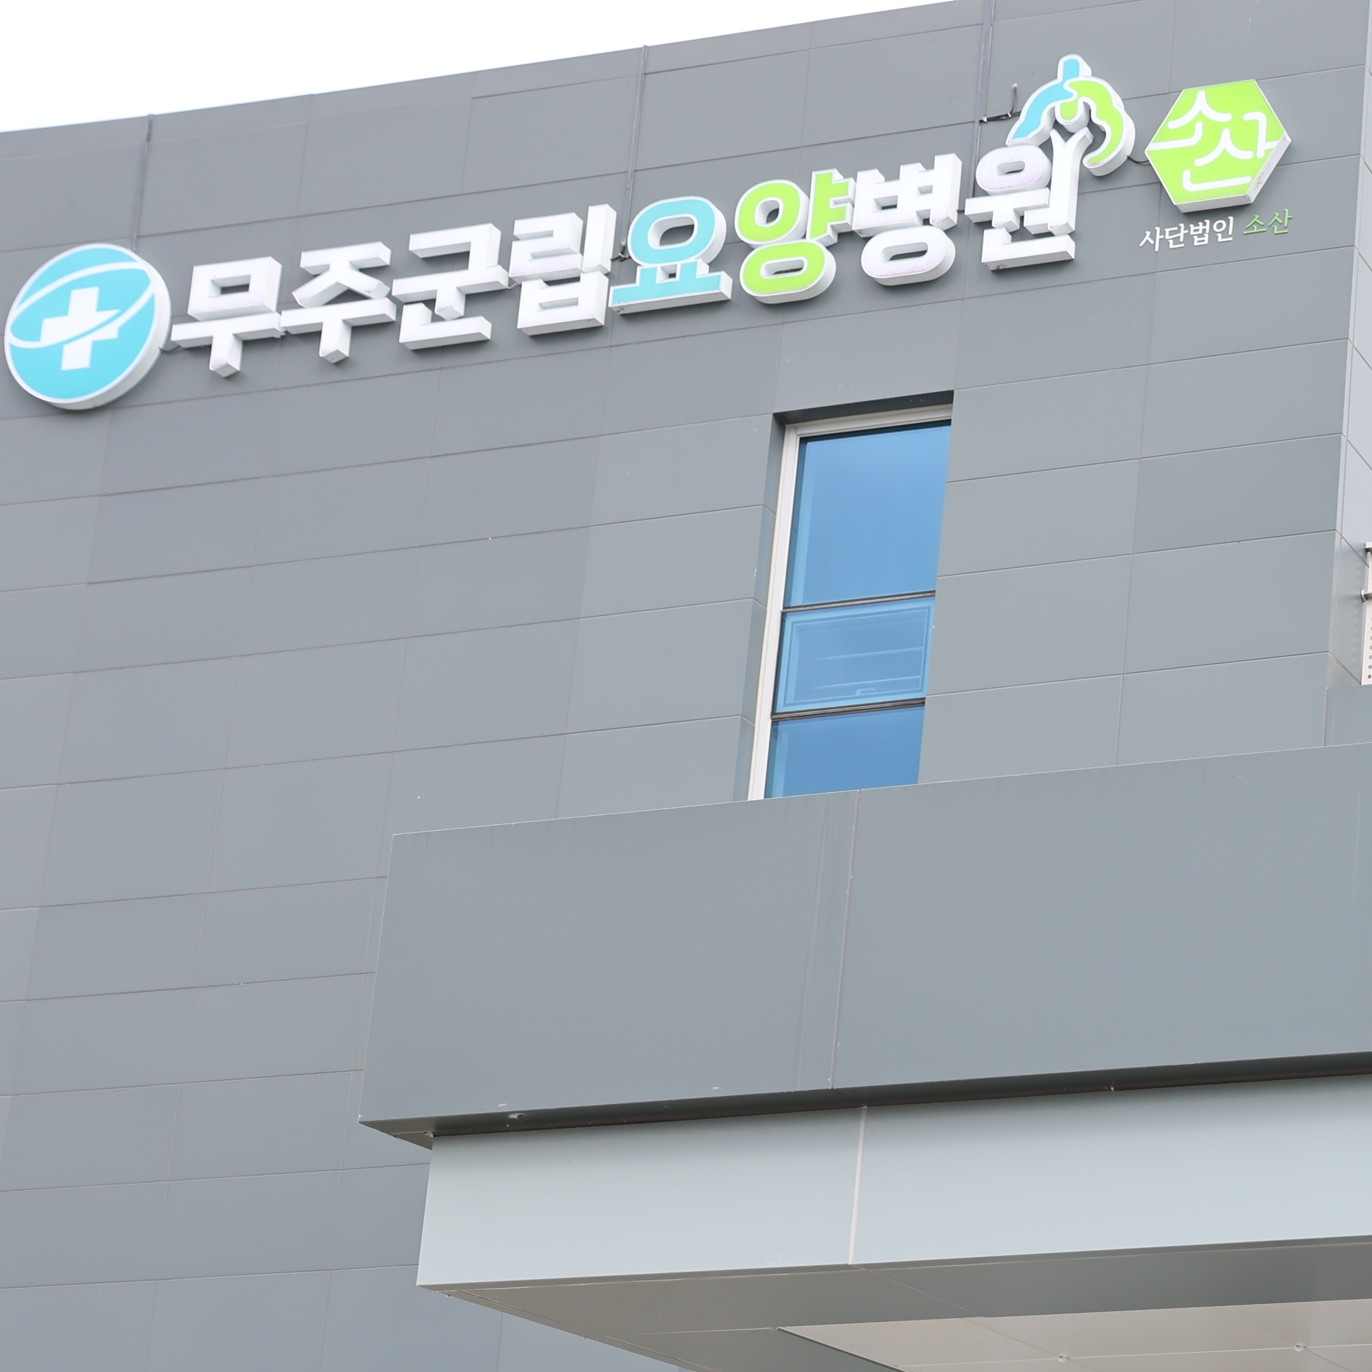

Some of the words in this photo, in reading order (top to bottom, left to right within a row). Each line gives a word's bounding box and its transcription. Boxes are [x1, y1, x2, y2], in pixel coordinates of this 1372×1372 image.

[171, 126, 1094, 378] 무주군립요양병원
[1139, 216, 1234, 252] 사단법인
[1243, 208, 1293, 235] 소산
